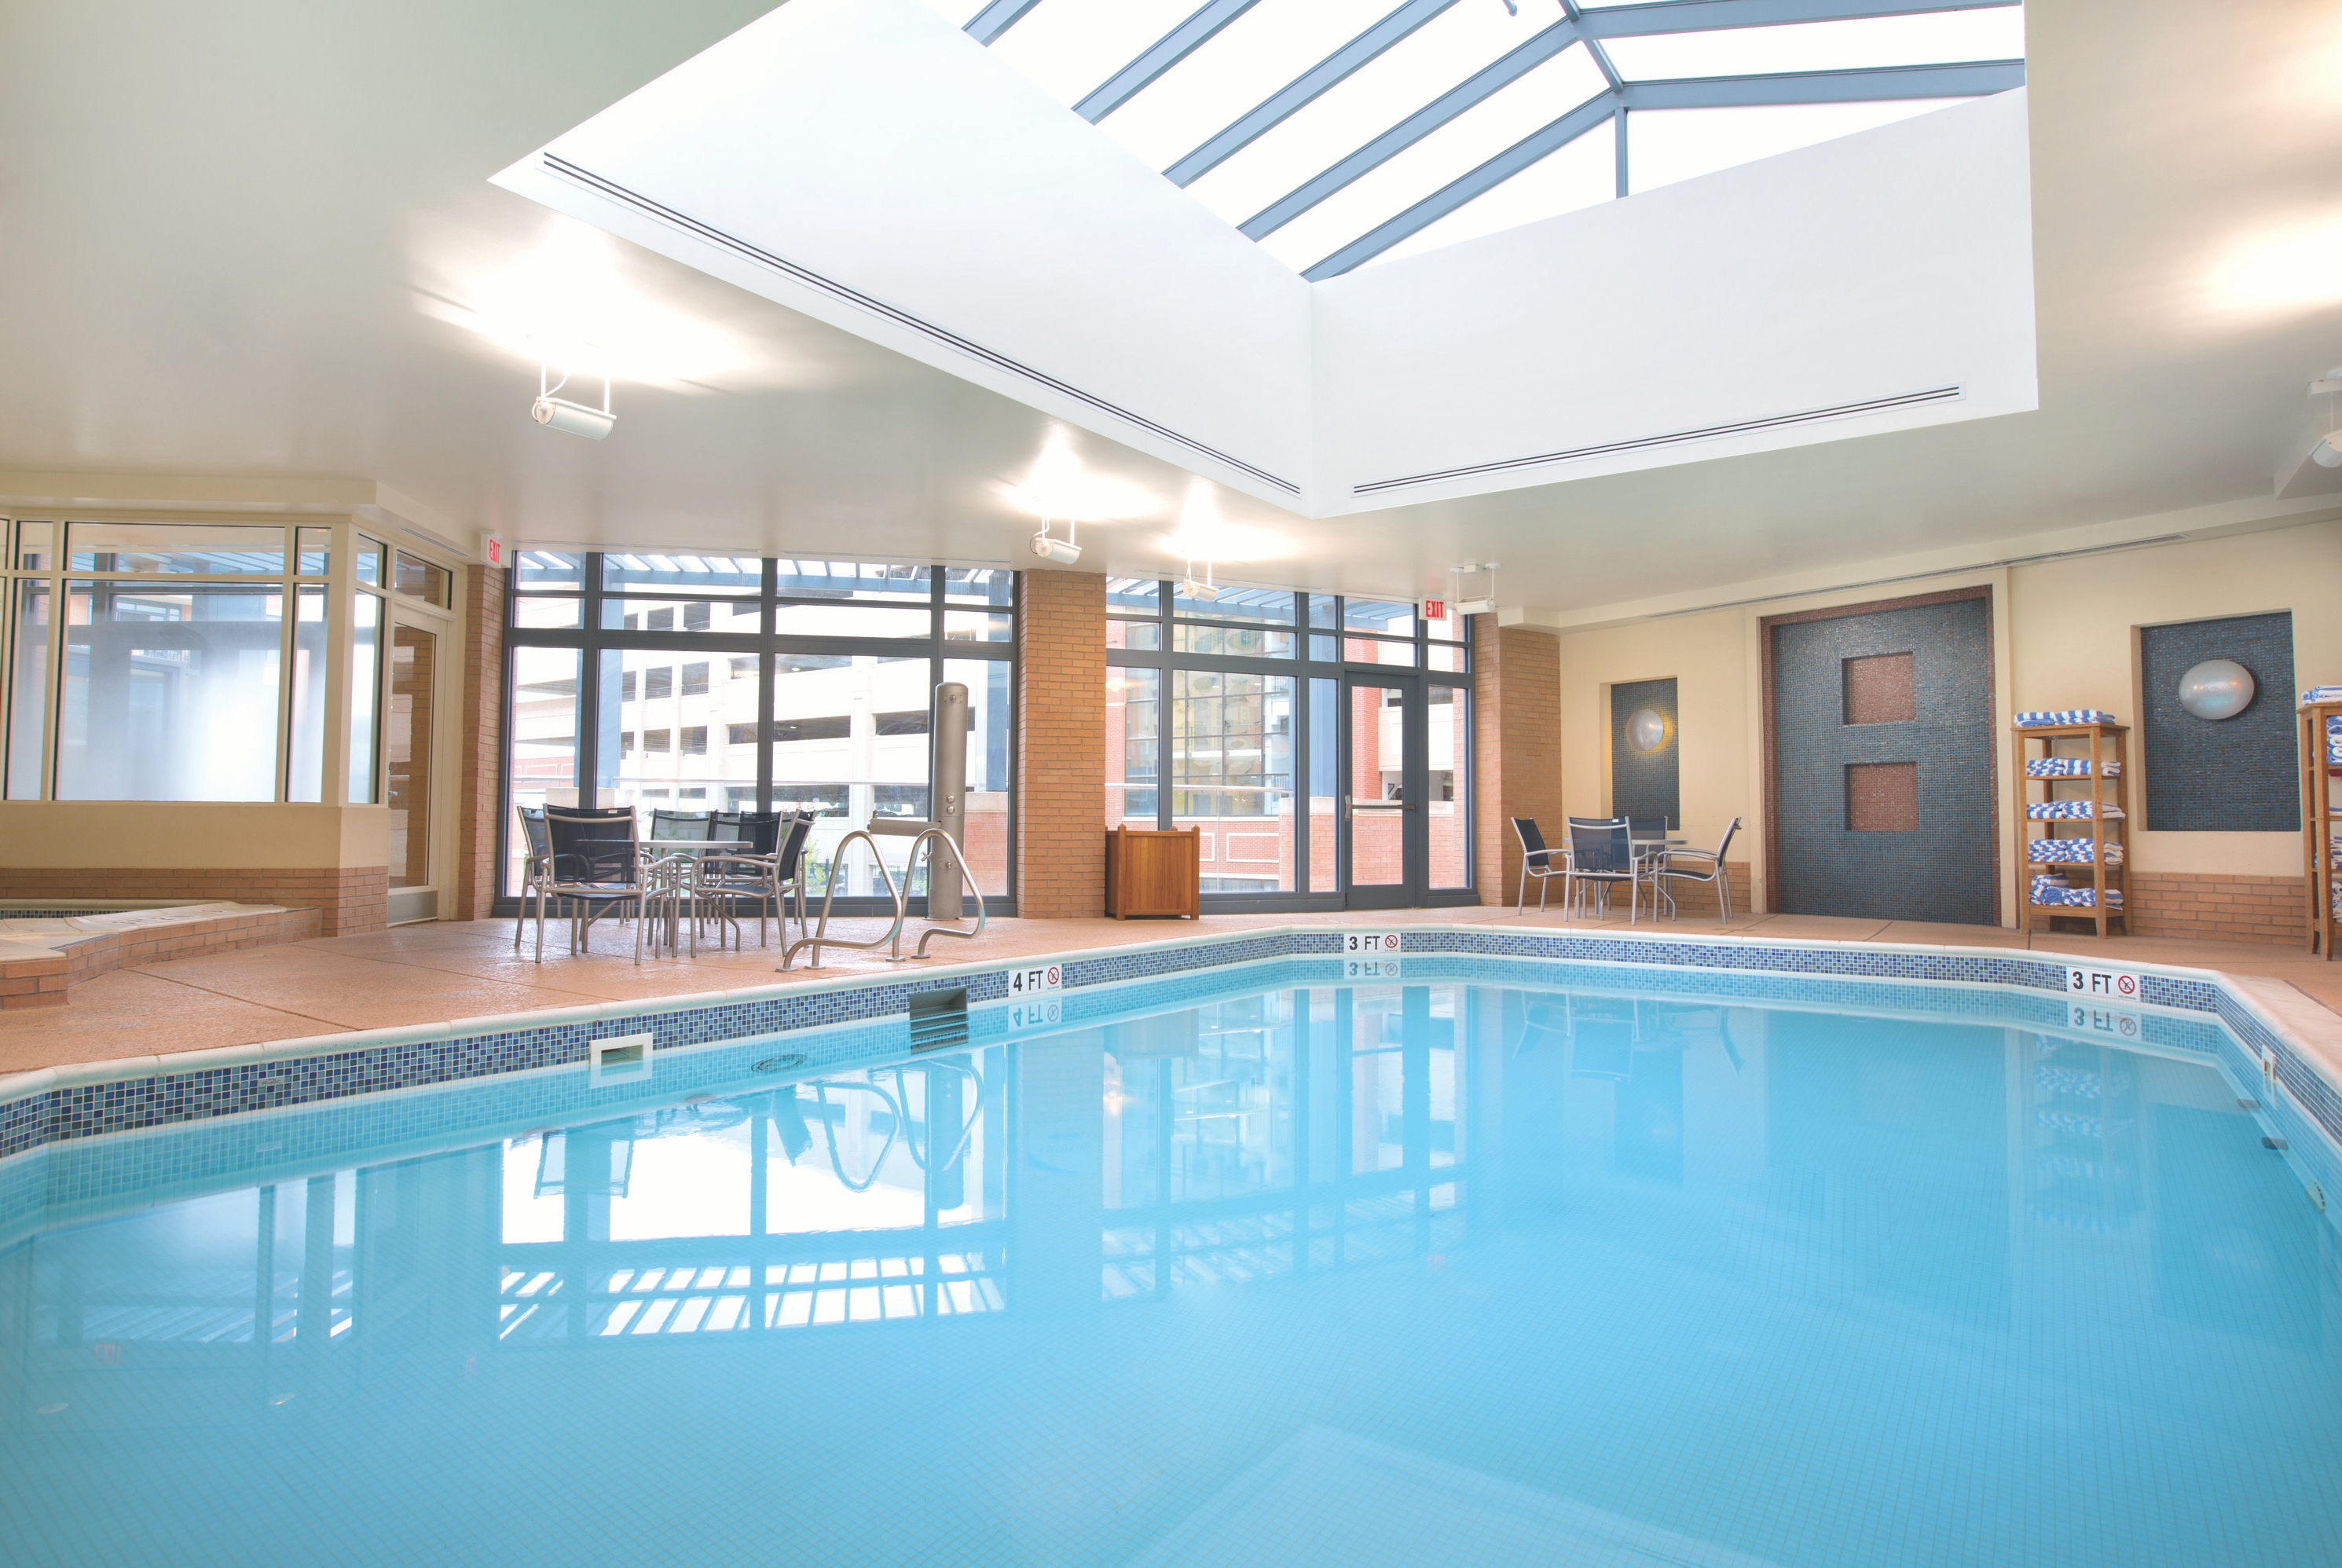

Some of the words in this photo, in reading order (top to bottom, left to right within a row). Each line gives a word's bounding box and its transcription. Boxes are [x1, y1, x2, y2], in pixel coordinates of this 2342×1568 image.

[489, 538, 500, 564] EXIT
[1425, 599, 1444, 618] EXIT
[1349, 936, 1358, 951] 3
[1365, 936, 1380, 951] FT
[1013, 973, 1023, 992] 4
[1028, 969, 1044, 991] FT
[2073, 971, 2084, 990] 3
[2091, 973, 2112, 994] FT
